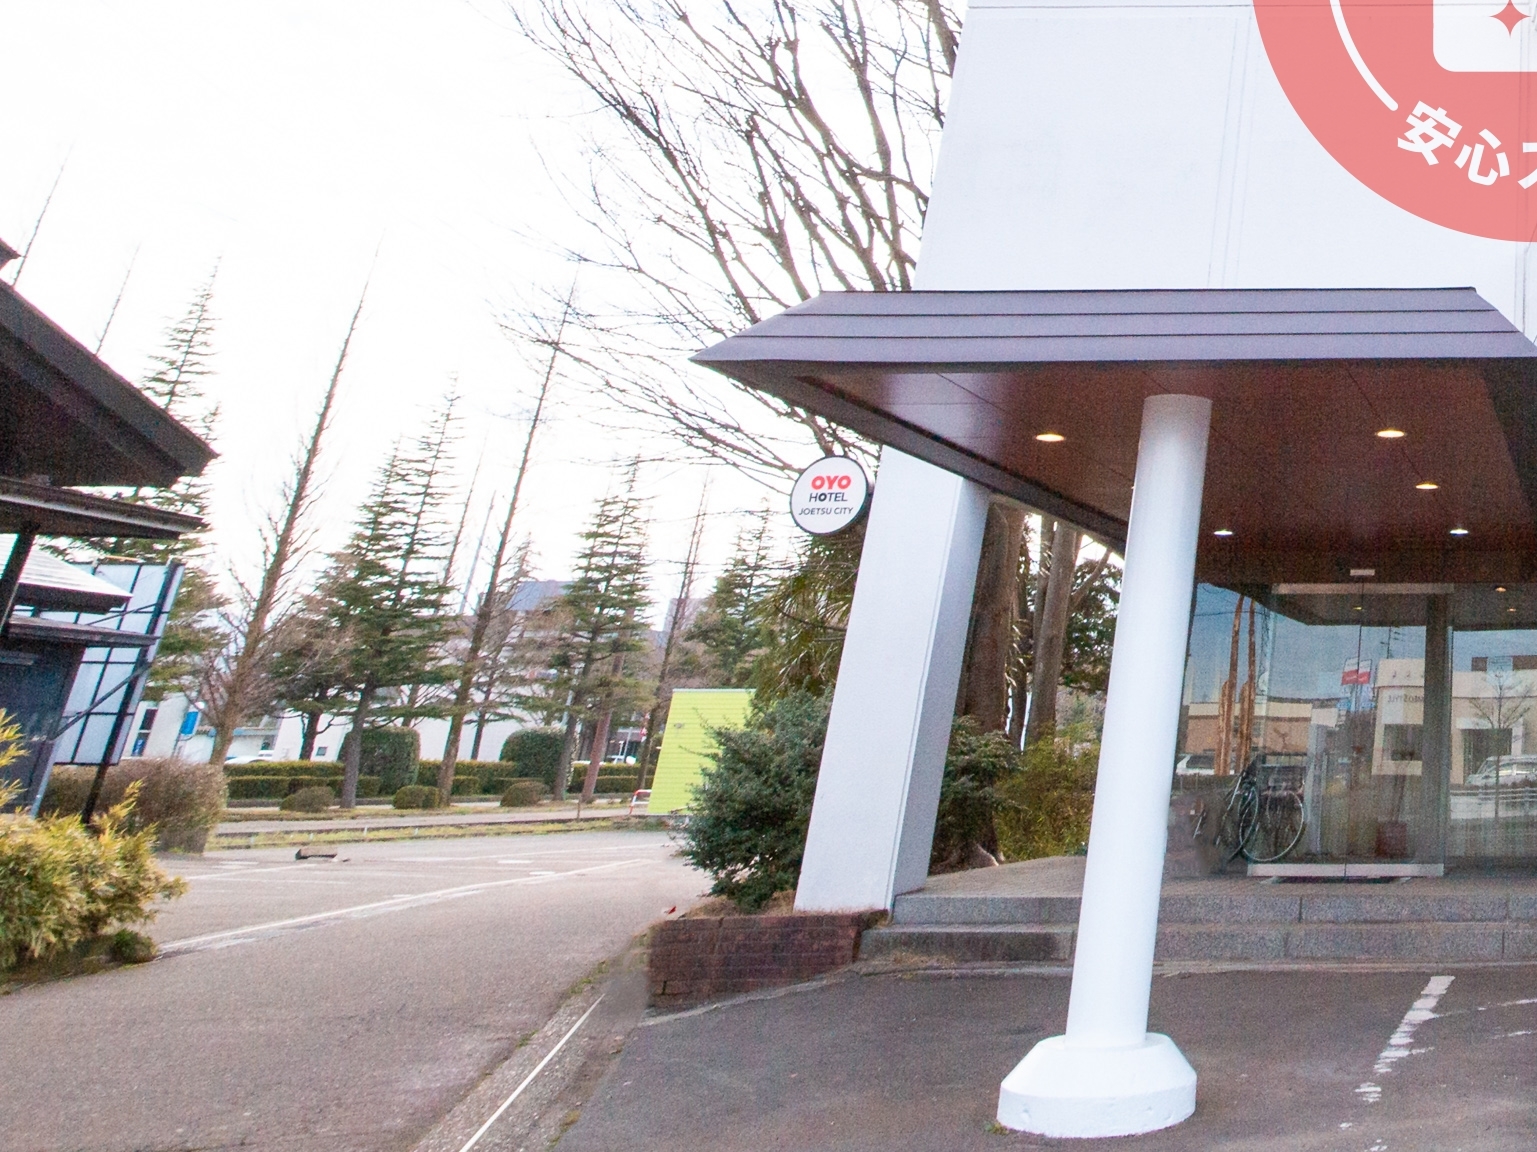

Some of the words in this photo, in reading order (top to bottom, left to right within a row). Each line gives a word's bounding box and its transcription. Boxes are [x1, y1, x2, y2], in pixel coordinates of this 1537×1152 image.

[811, 475, 852, 490] OYO
[808, 492, 848, 503] HOTEL
[798, 507, 832, 516] JOETSU
[833, 506, 854, 515] CITY
